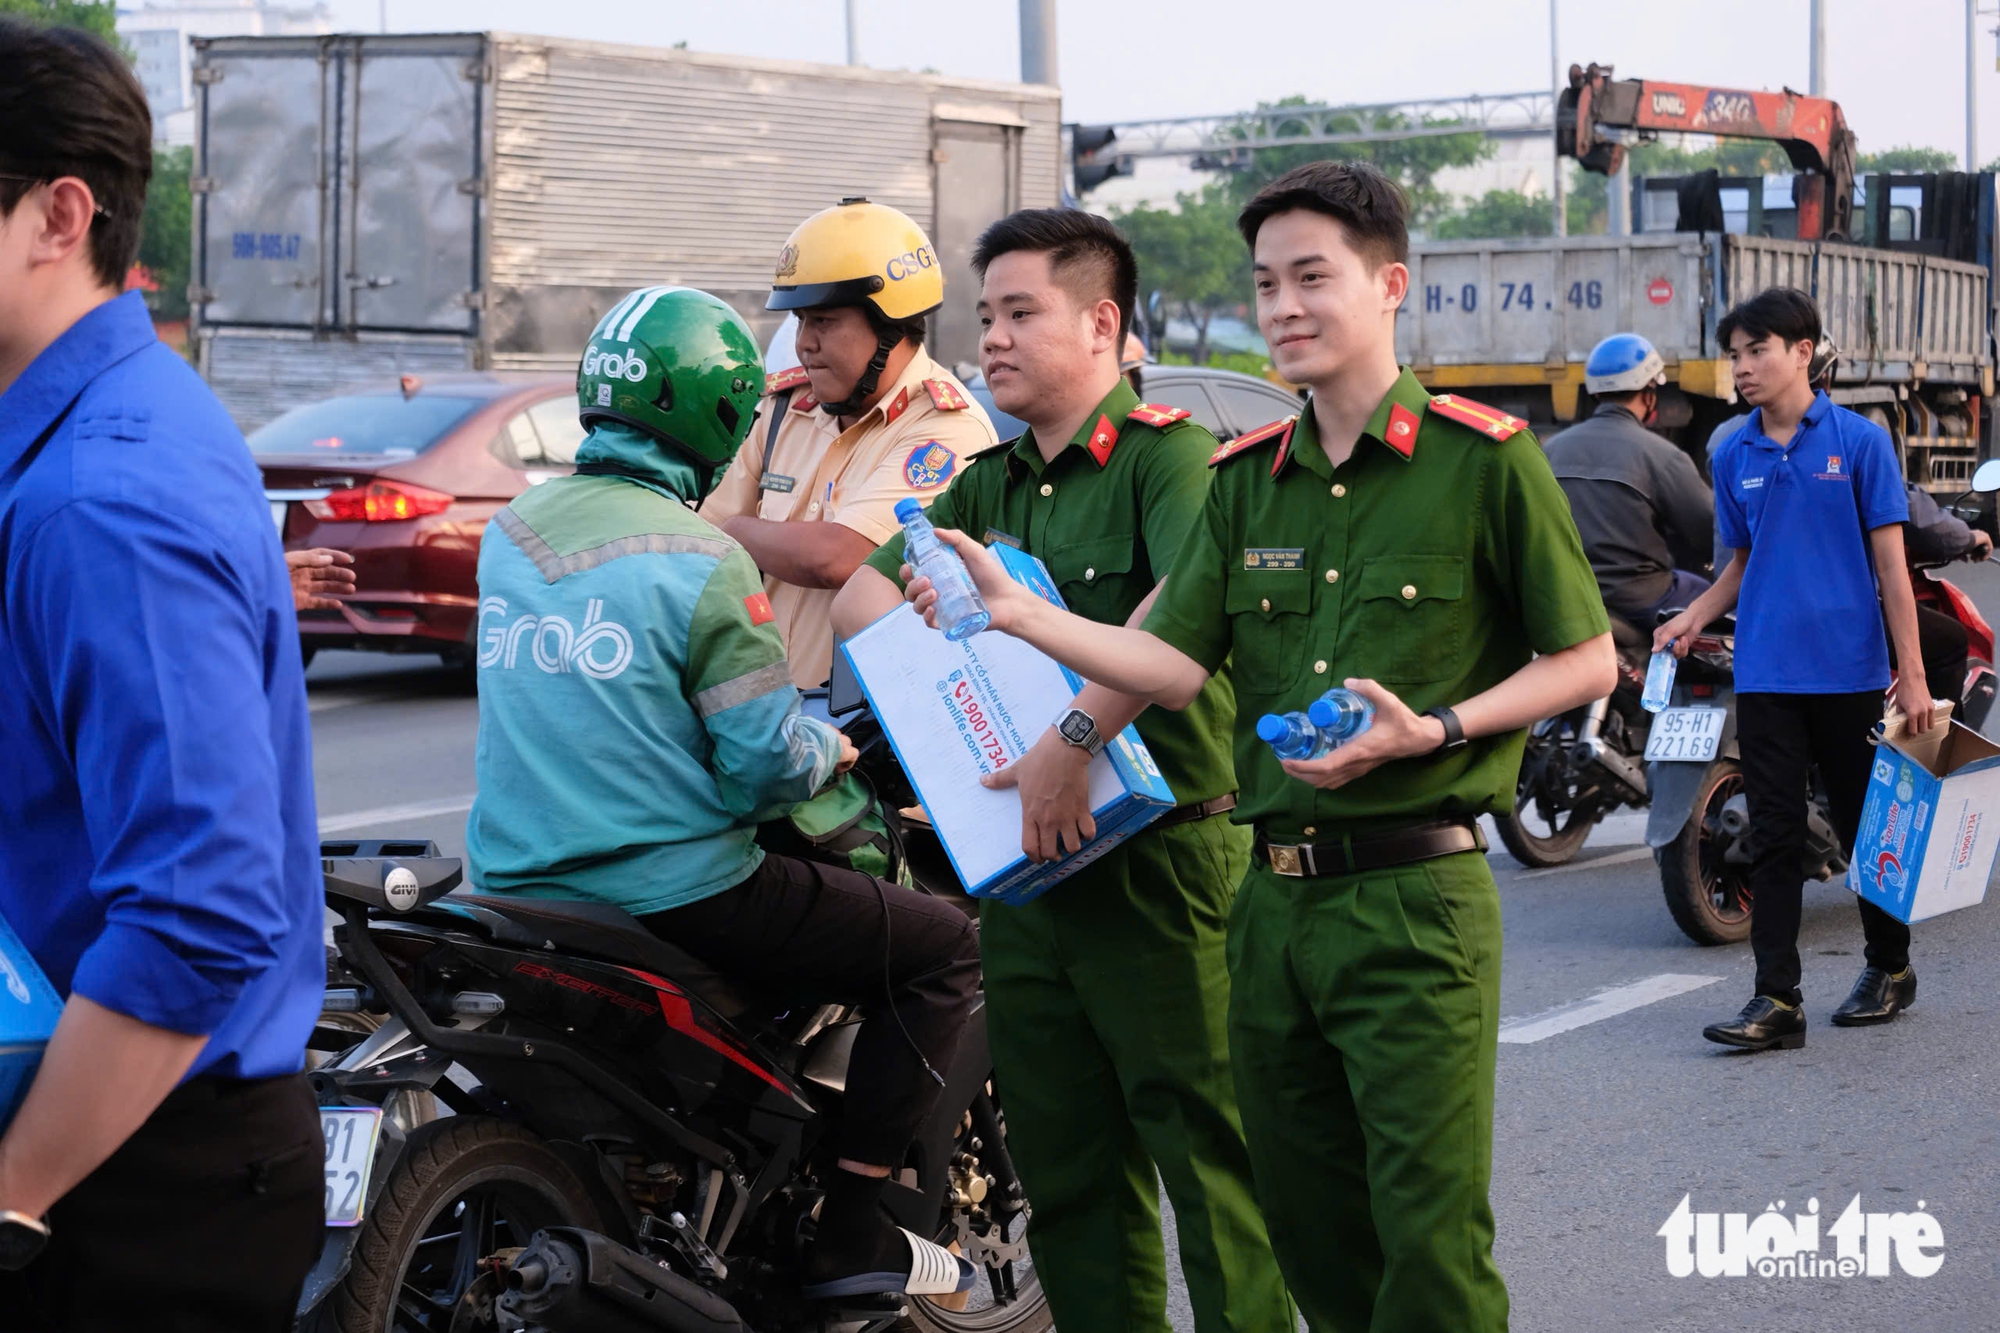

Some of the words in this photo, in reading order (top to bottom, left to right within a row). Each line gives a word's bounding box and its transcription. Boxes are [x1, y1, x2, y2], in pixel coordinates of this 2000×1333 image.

[583, 346, 648, 383] Grab
[478, 596, 634, 680] Grab
[961, 639, 972, 654] NG
[969, 652, 979, 664] TY
[975, 664, 988, 678] CỔ
[995, 702, 1015, 729] NƯỚC
[960, 694, 988, 732] 1900
[980, 730, 1008, 769] 1734
[1663, 713, 1712, 733] 95-H1
[1650, 736, 1714, 757] 221.69
[391, 884, 416, 896] GIVI
[513, 961, 659, 1016] EXCITER
